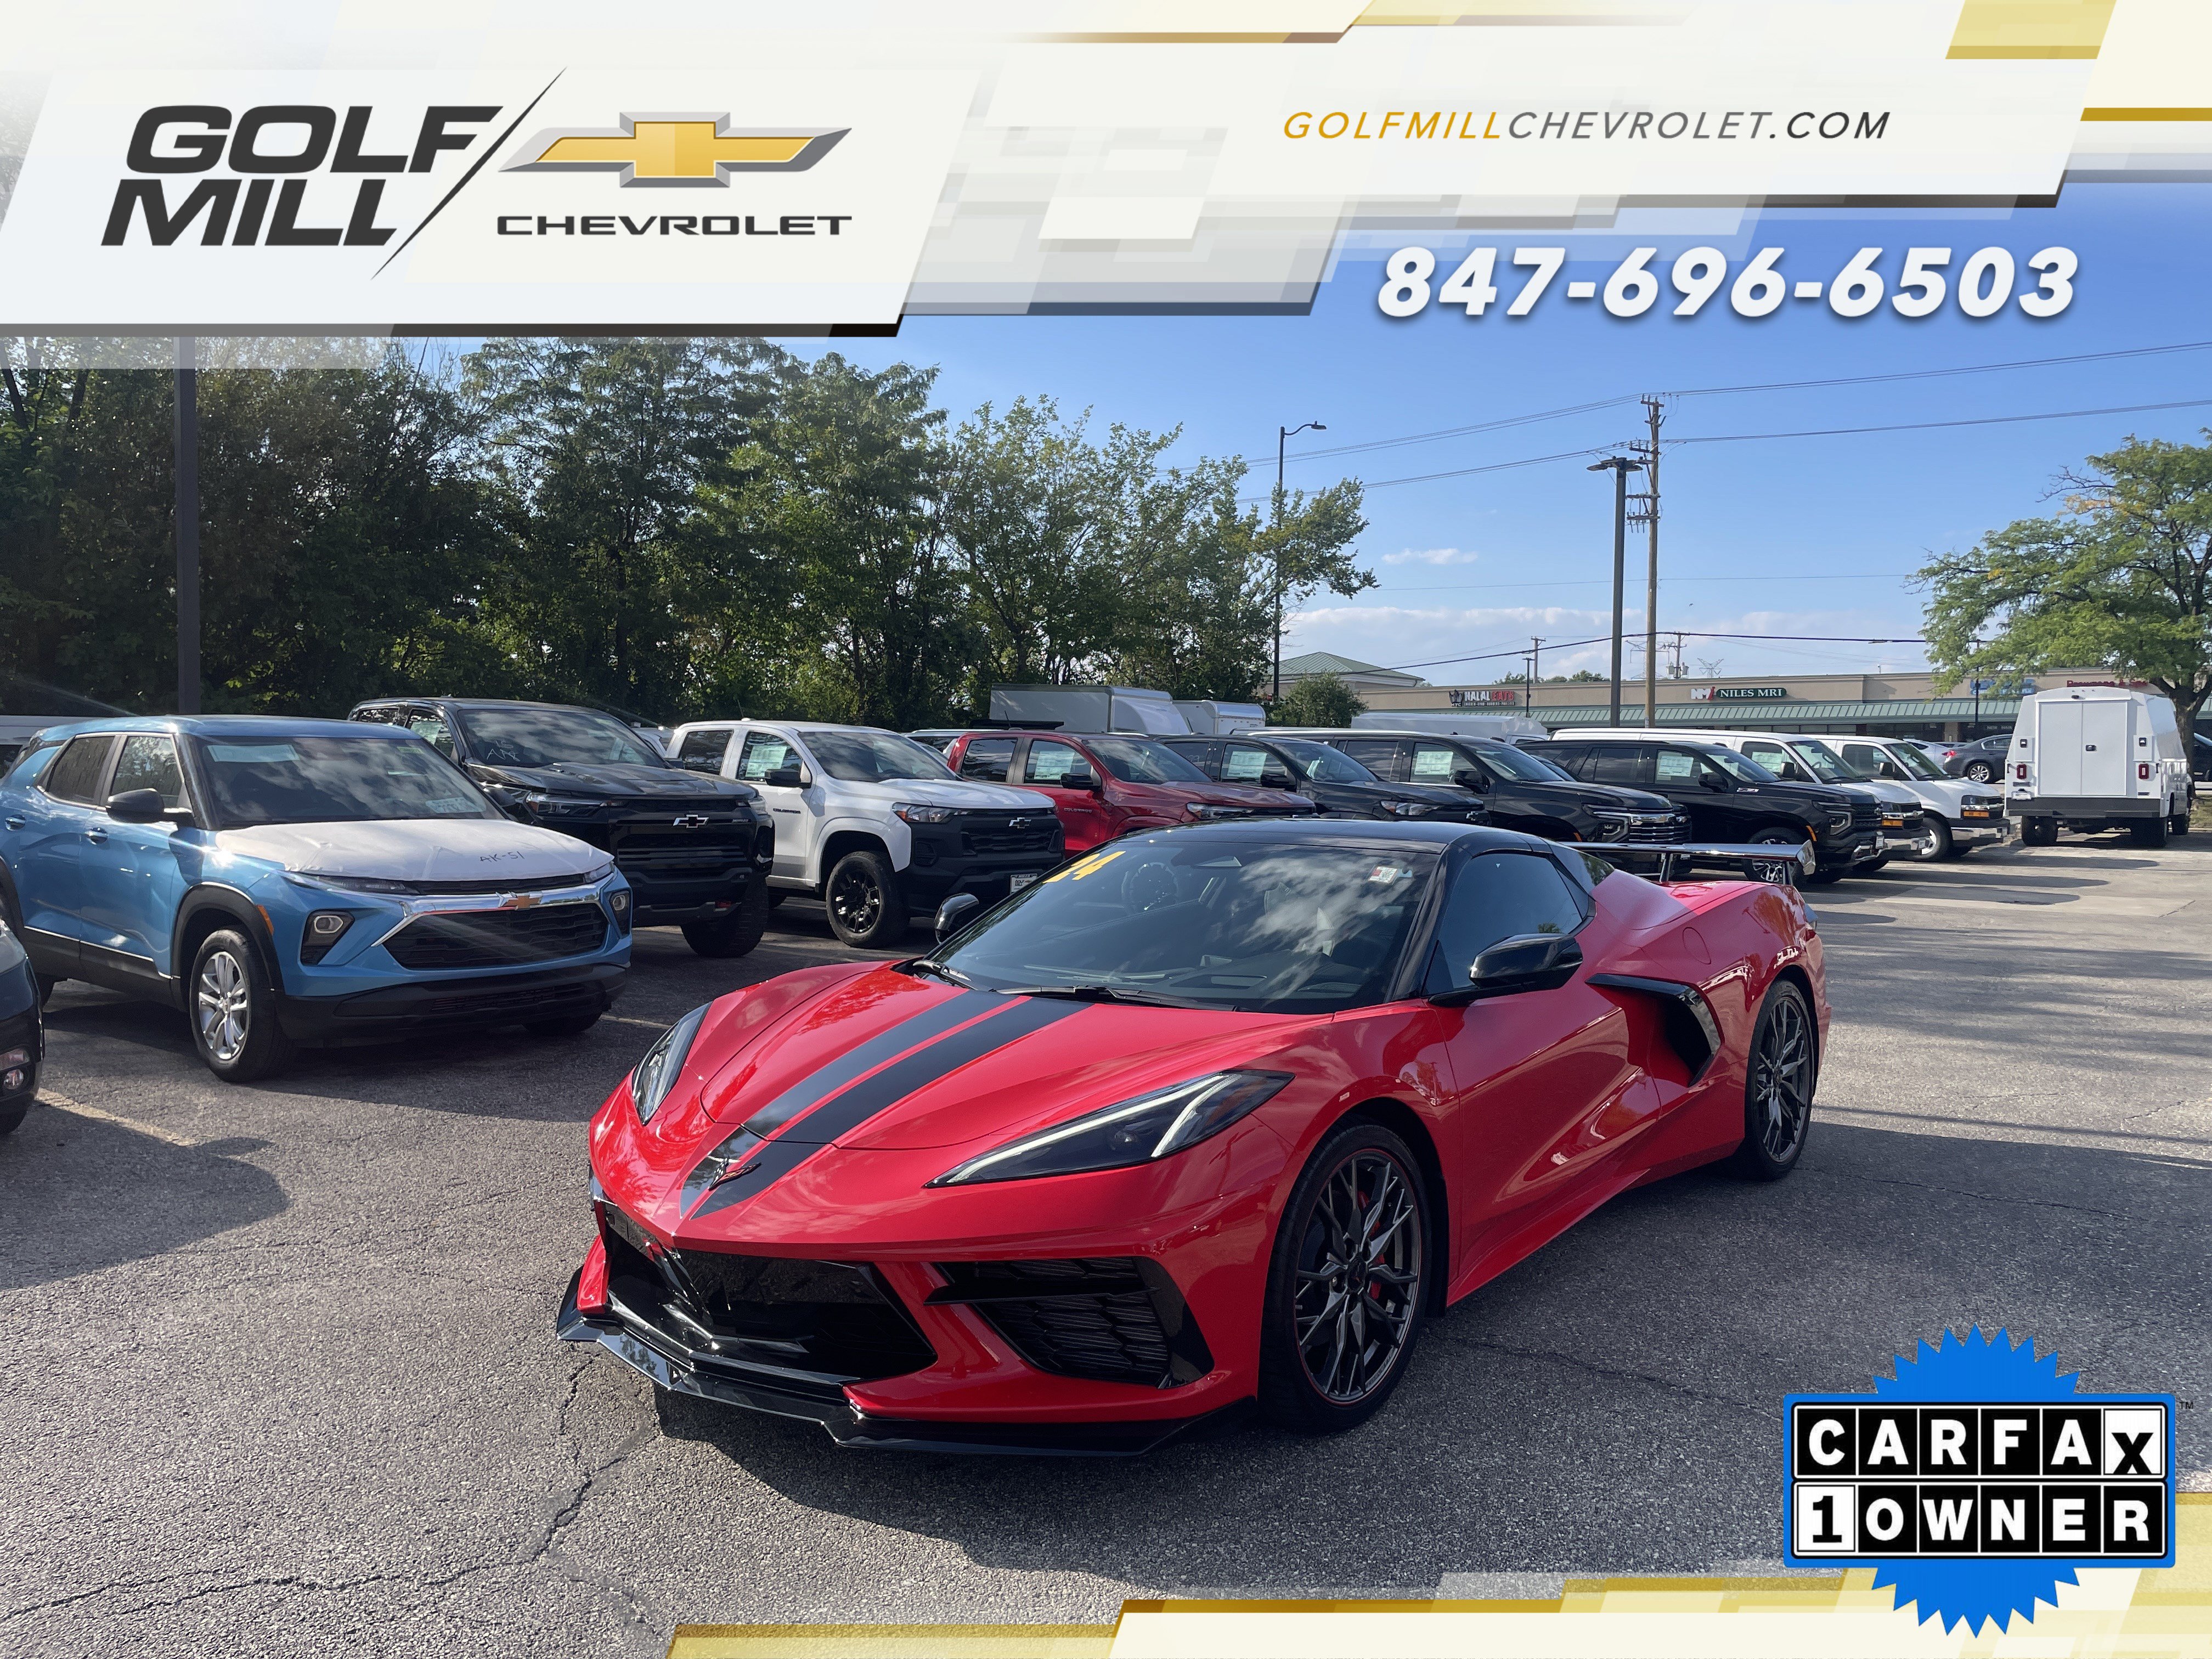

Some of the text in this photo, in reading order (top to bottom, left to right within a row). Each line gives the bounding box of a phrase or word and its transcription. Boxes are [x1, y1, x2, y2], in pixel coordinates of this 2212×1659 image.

[1464, 690, 1515, 701] HALAL EATS
[1720, 689, 1782, 697] NILES MRI
